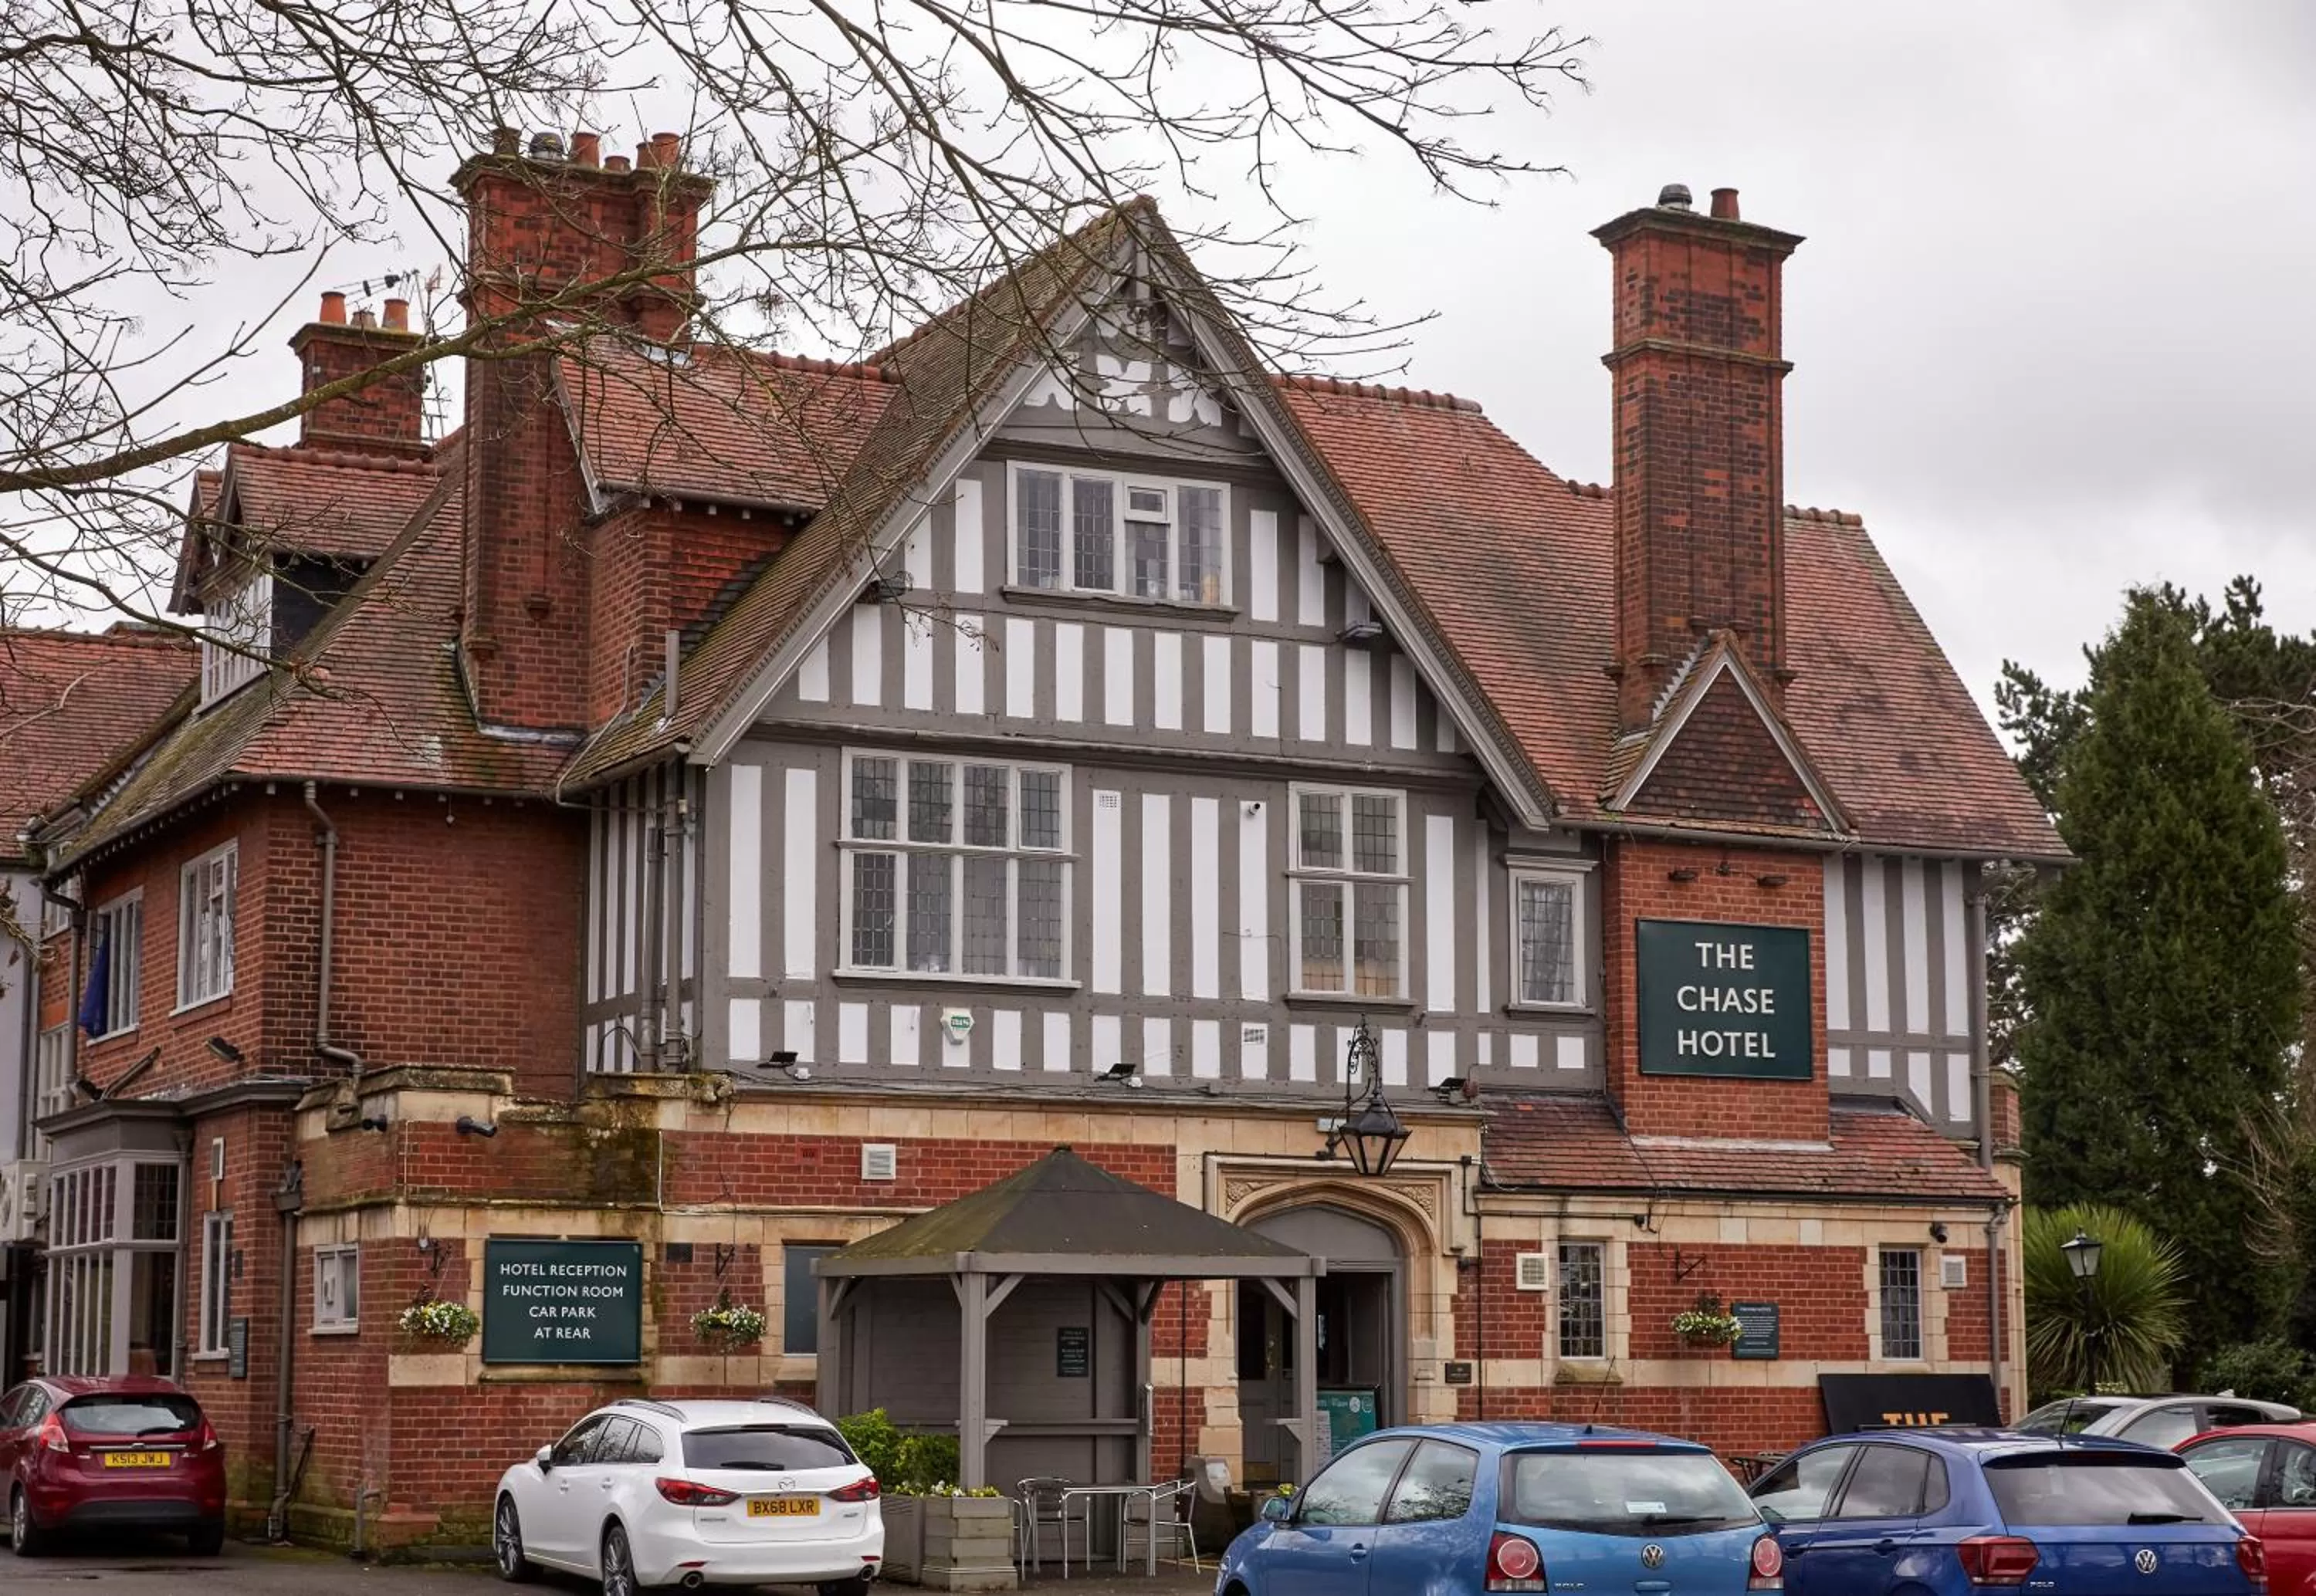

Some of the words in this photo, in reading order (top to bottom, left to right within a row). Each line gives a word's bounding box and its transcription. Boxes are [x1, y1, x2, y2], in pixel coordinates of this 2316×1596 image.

[1695, 942, 1755, 969] THE
[1676, 985, 1775, 1014] CHASE
[1677, 1029, 1776, 1058] HOTEL
[499, 1263, 546, 1276] HOTEL
[550, 1265, 627, 1277] RECEPTION
[503, 1284, 578, 1297] FUNCTION
[582, 1286, 624, 1297] ROOM
[529, 1306, 557, 1317] CAR
[561, 1306, 597, 1317] PARK
[533, 1327, 552, 1339] AT
[556, 1327, 591, 1339] REAR
[141, 1454, 164, 1464] JWJ
[753, 1500, 787, 1515] BX68
[789, 1499, 815, 1514] LXR
